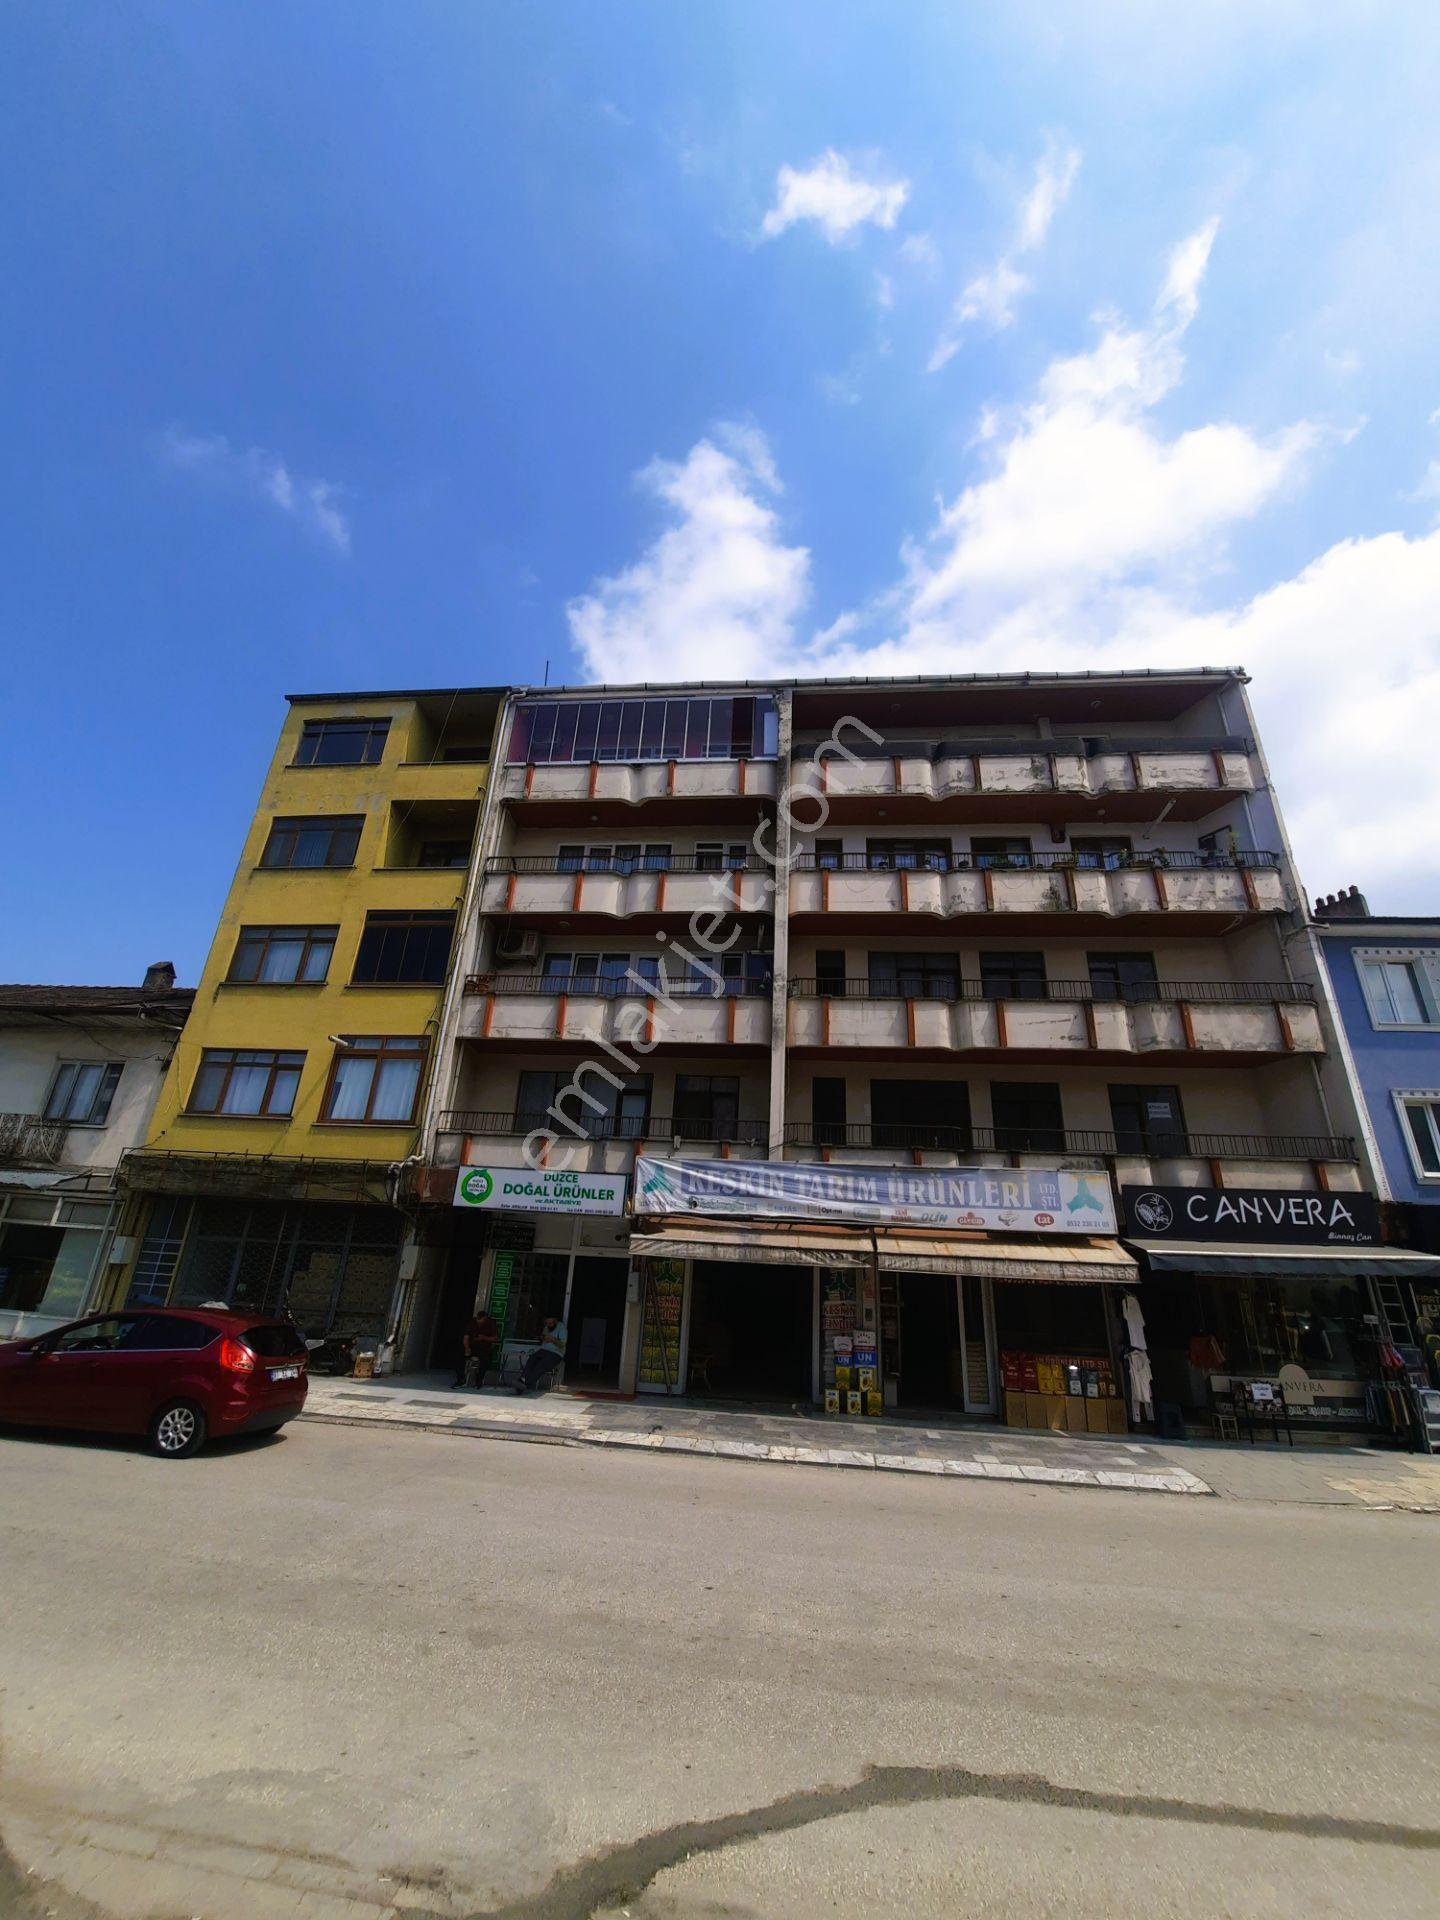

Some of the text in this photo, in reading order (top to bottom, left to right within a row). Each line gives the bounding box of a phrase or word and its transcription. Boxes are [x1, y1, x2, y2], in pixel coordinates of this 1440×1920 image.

[503, 1182, 615, 1200] DOĞAL ÜRÜNLER
[688, 1166, 1033, 1209] KESKİN TARIM ÜRÜNLERİ
[1187, 1195, 1356, 1227] CANVERA
[1036, 1215, 1051, 1225] tat
[1356, 1232, 1372, 1242] Can
[857, 1352, 873, 1362] UN
[1282, 1381, 1325, 1393] NVERA
